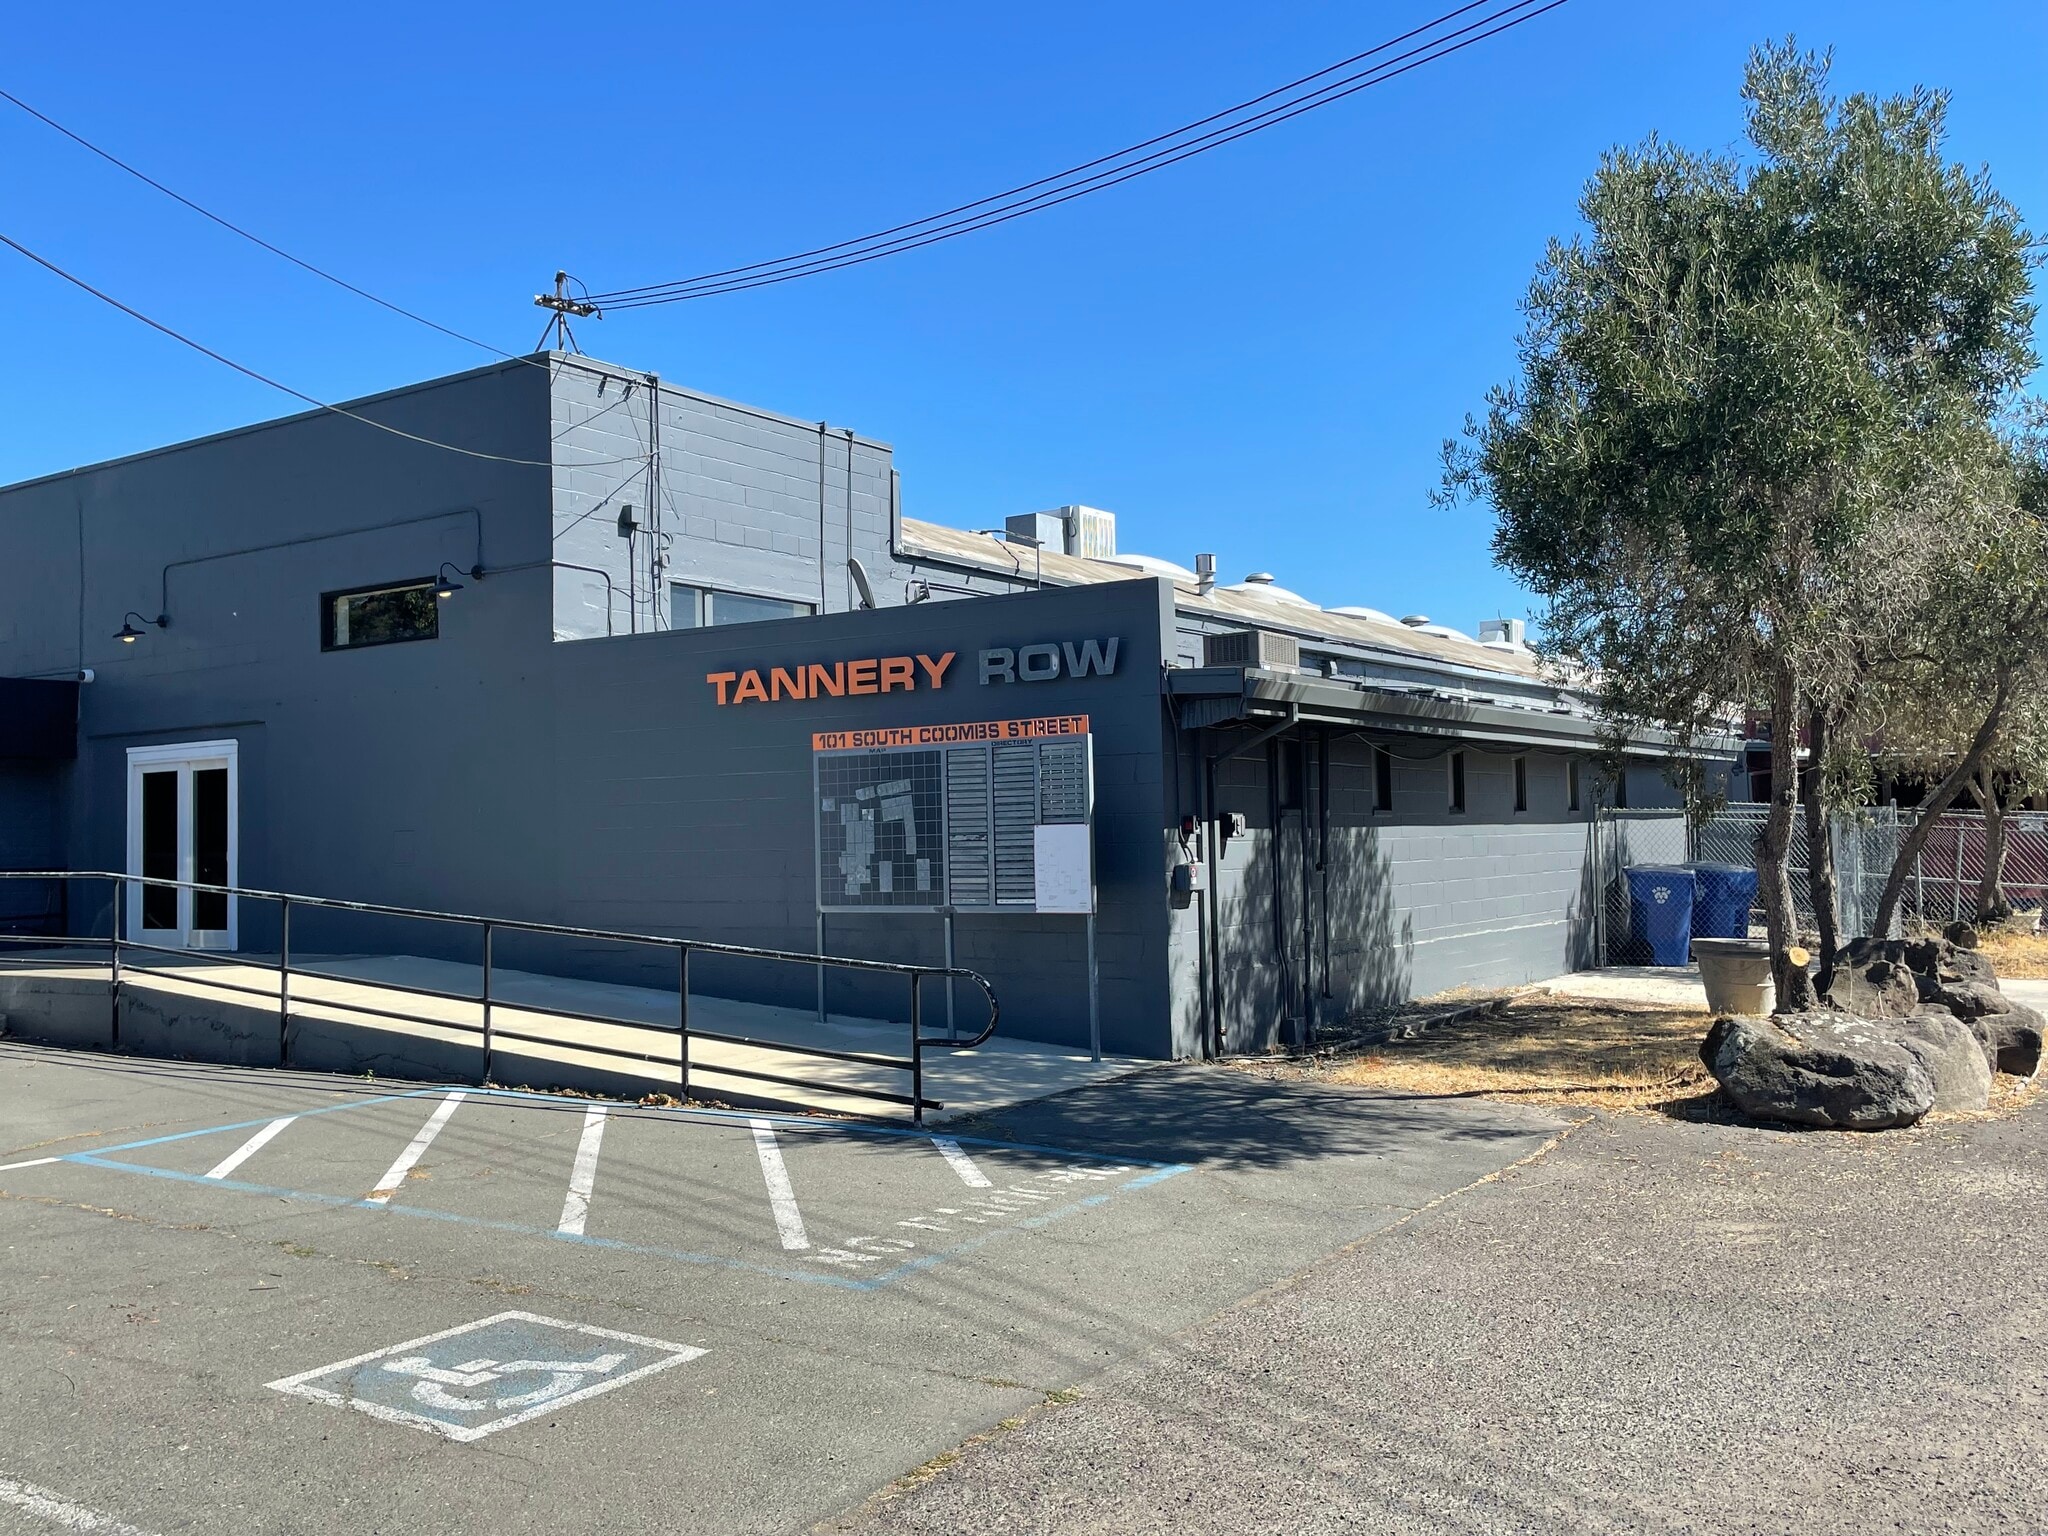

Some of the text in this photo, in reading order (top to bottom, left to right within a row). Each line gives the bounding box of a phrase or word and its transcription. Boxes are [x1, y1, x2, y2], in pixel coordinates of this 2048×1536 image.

[706, 637, 1119, 705] TANNERY ROW
[819, 717, 1082, 749] 101 SOUTH COOMBS STREET
[991, 738, 1033, 747] DIRECTORY
